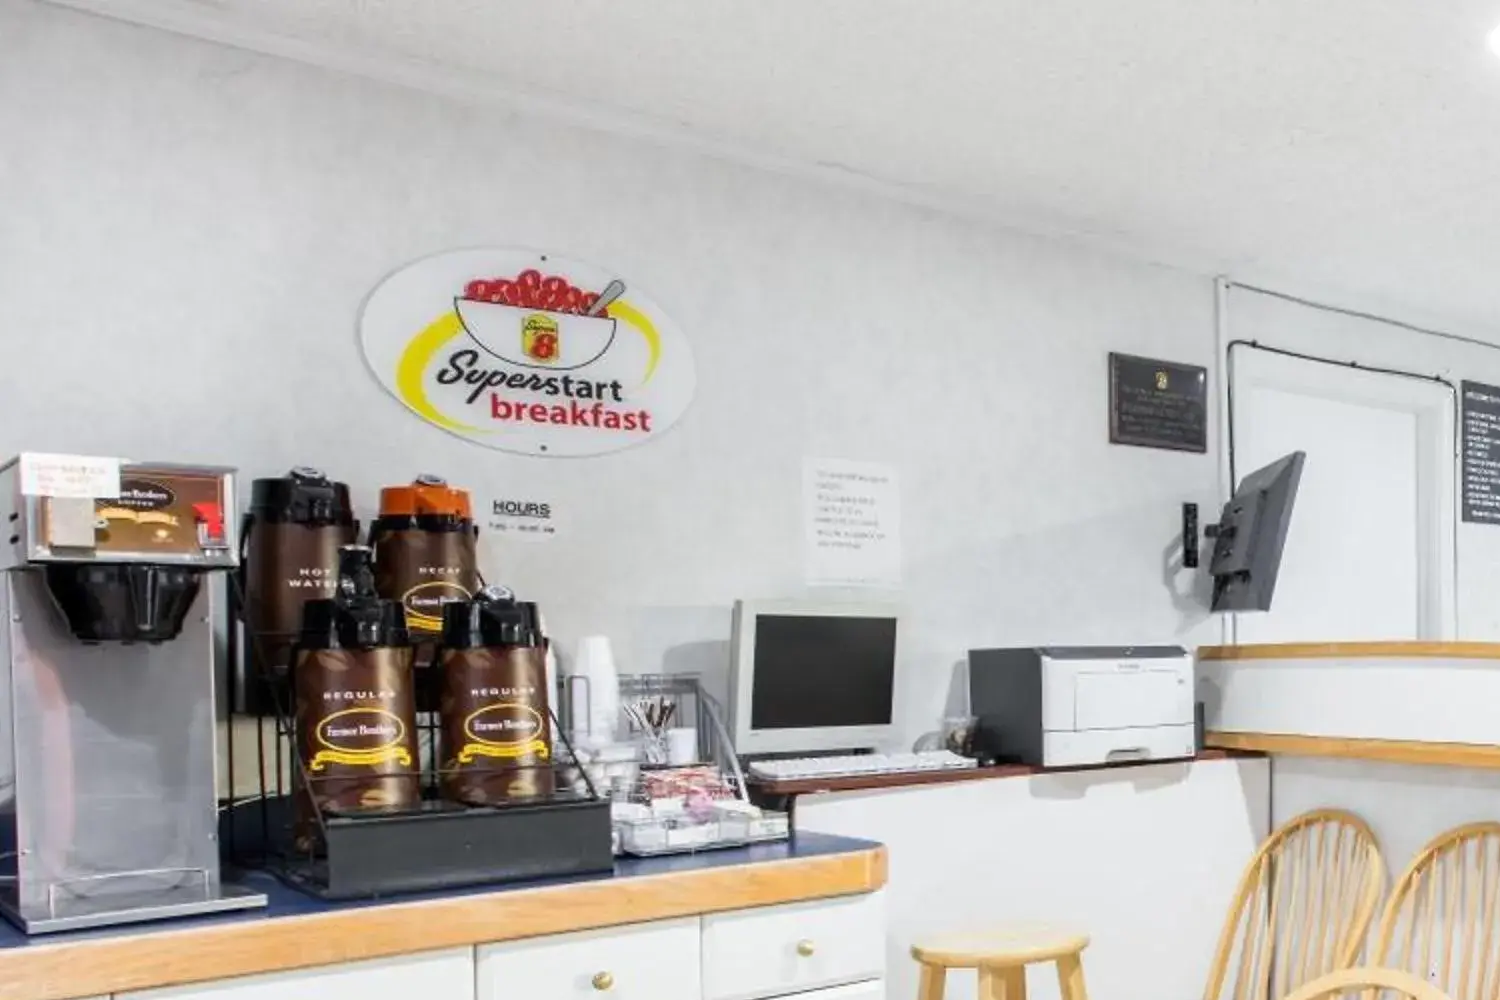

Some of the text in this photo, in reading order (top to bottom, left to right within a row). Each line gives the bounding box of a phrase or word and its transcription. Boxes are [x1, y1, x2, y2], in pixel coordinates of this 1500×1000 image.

[436, 349, 624, 404] Superstart
[490, 393, 651, 432] breakfast
[493, 499, 551, 518] HOURS
[299, 568, 332, 577] HOT
